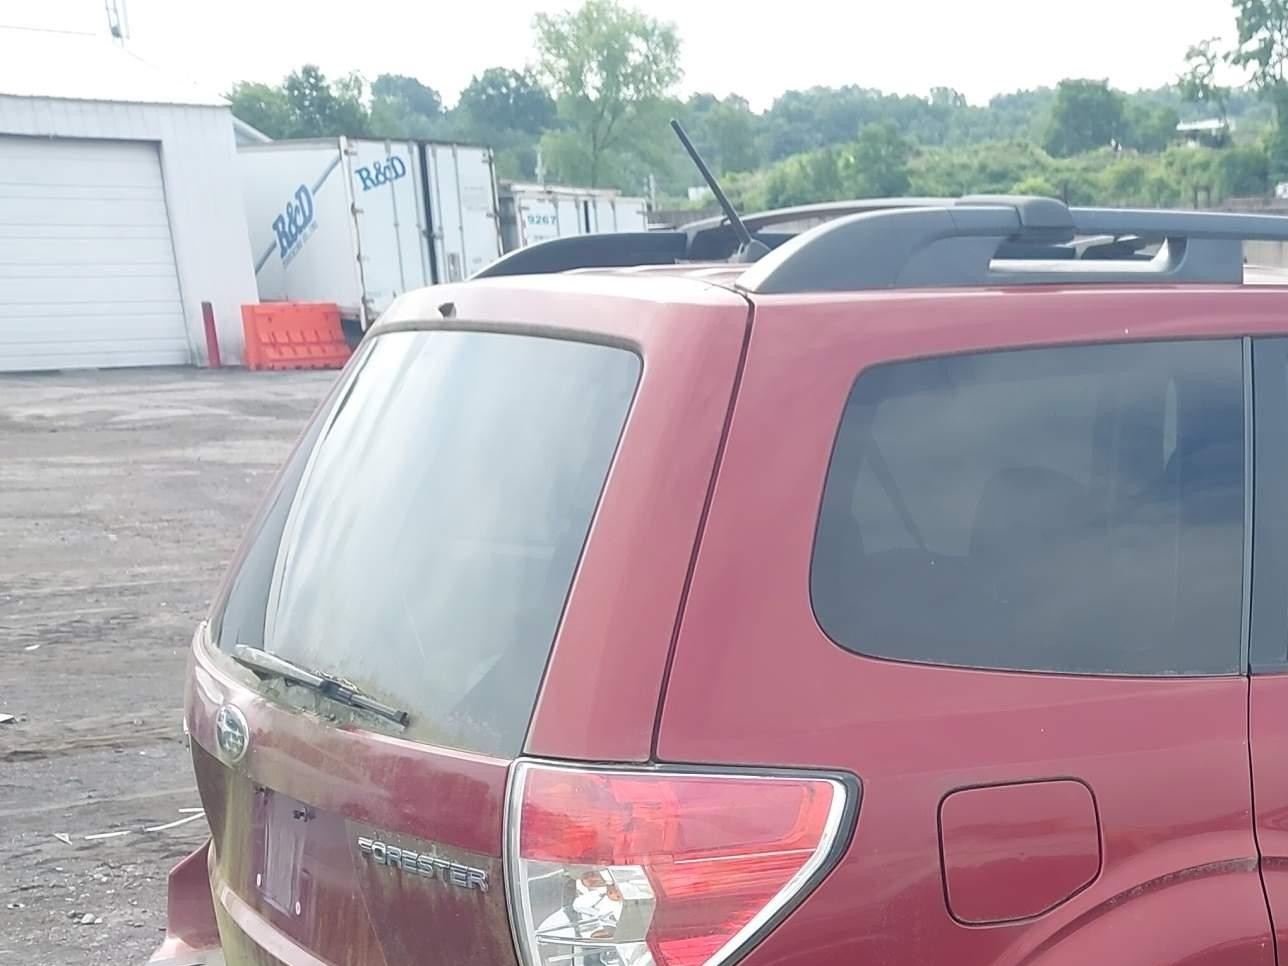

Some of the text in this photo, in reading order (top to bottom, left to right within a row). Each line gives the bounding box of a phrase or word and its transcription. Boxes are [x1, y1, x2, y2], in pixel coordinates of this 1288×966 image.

[355, 156, 406, 191] R&D
[272, 184, 313, 258] R&D
[527, 215, 557, 225] 9267
[358, 836, 488, 893] FORESTER
